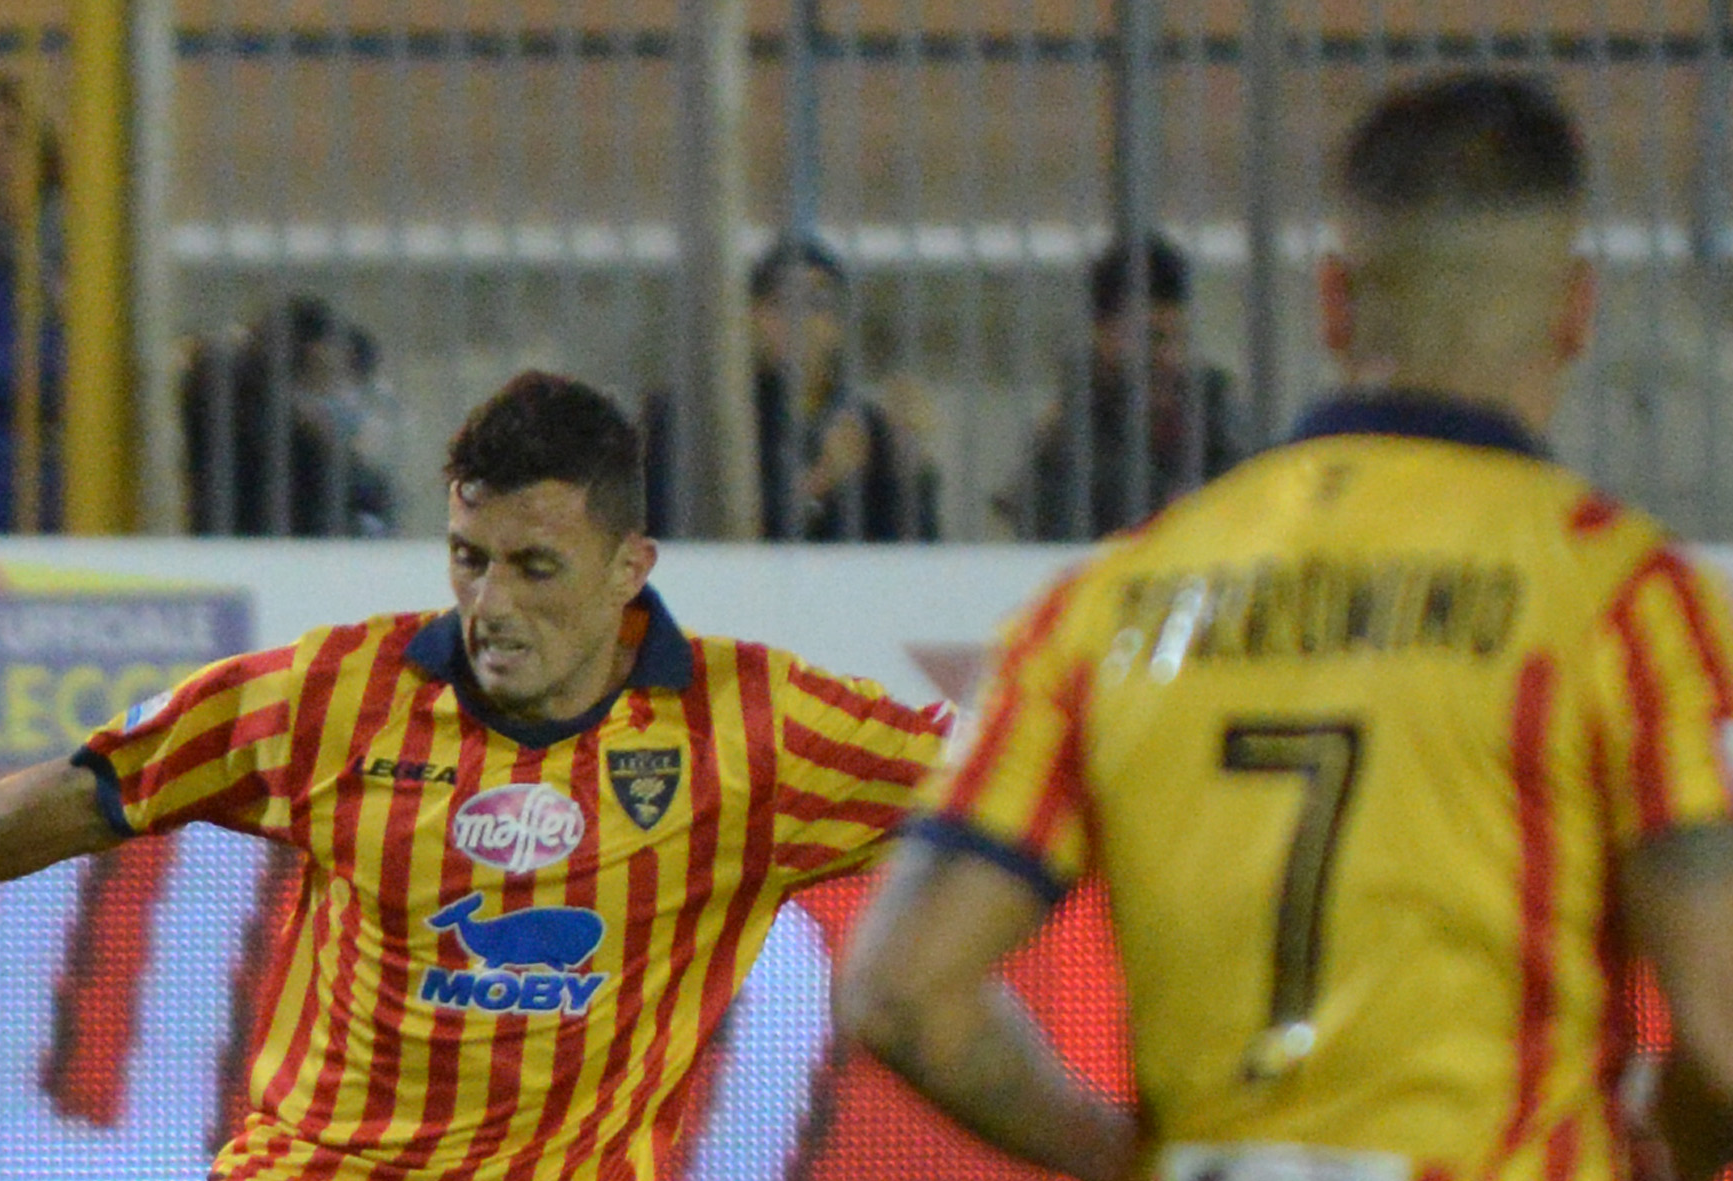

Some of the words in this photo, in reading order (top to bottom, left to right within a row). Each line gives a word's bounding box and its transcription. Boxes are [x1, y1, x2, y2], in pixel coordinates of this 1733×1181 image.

[456, 782, 585, 874] maffei
[1216, 715, 1366, 1083] 7
[419, 967, 609, 1016] MOBY
